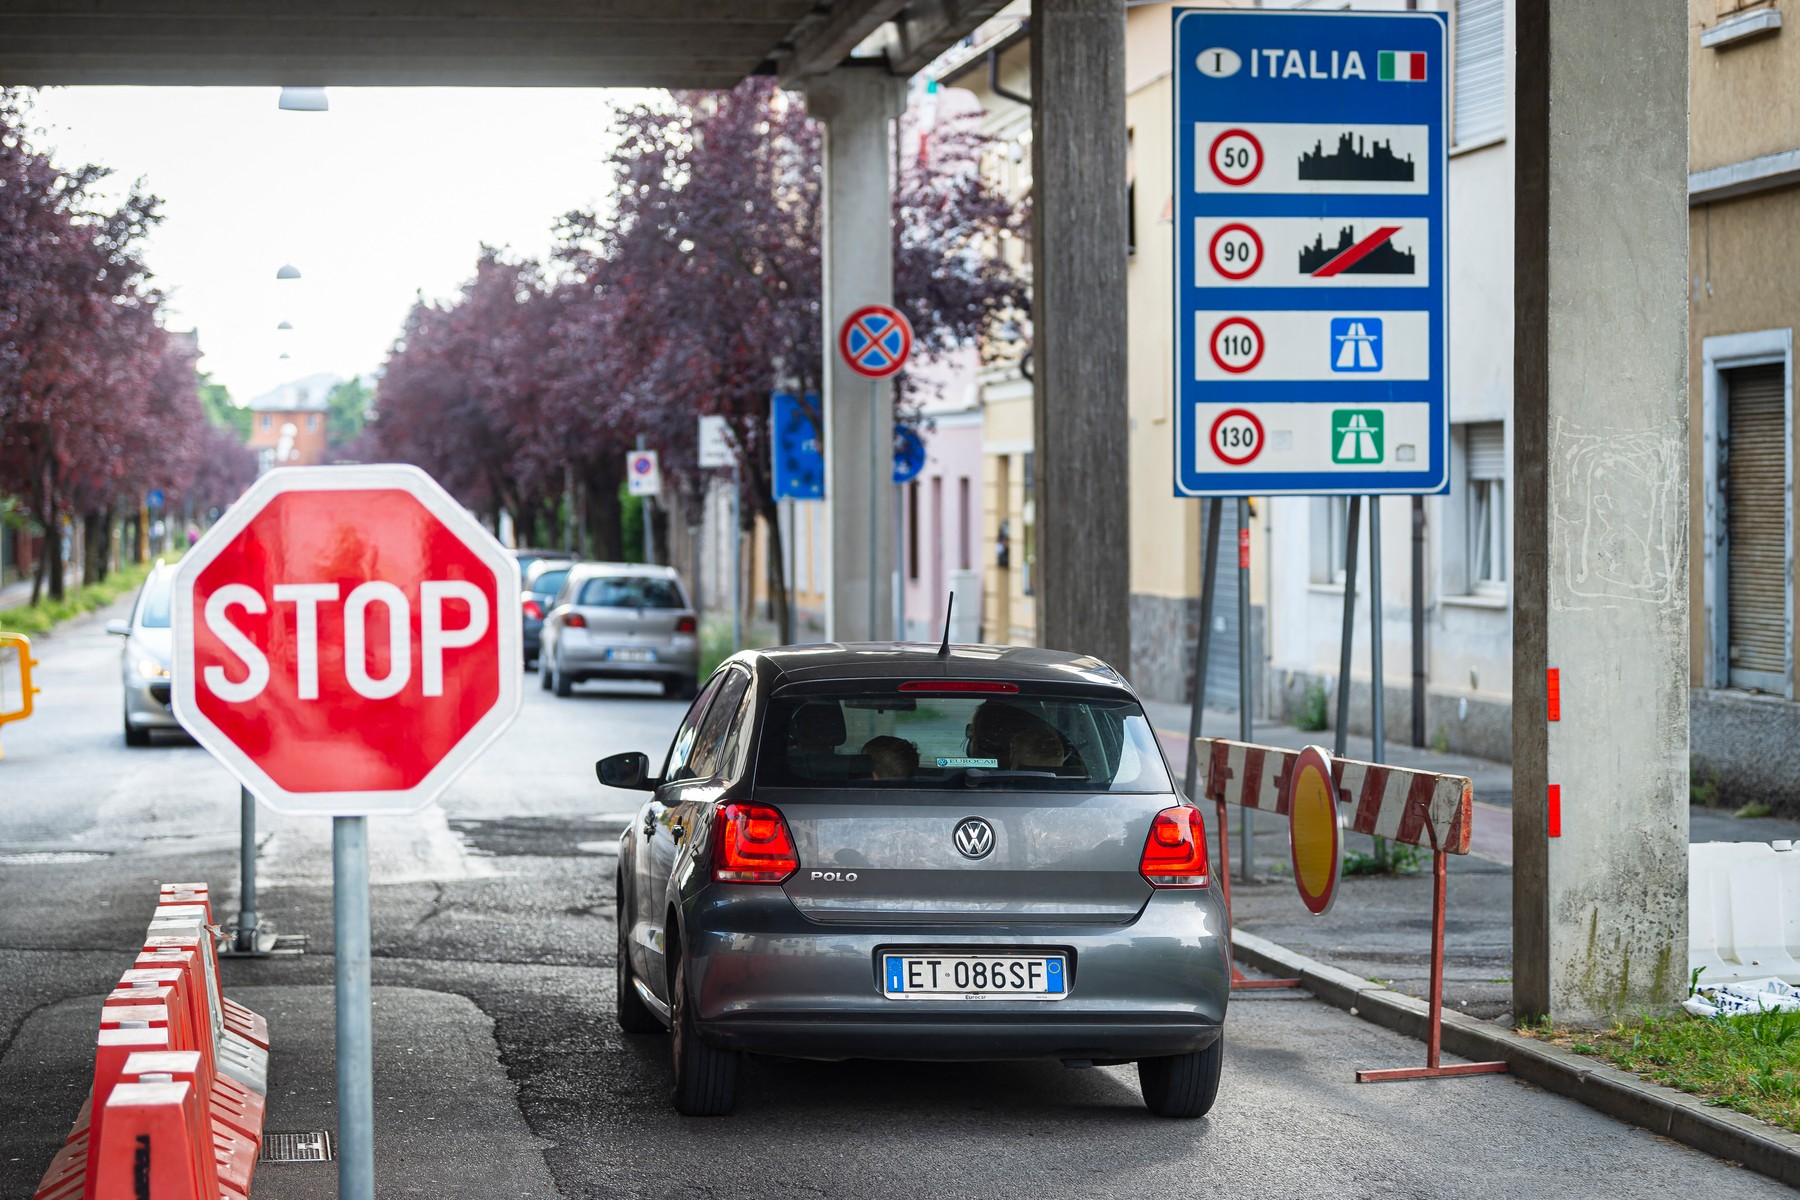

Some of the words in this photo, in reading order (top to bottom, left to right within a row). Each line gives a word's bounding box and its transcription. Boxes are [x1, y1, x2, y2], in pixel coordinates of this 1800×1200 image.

[1250, 48, 1367, 80] ITALIA
[1223, 147, 1250, 168] 50
[1224, 241, 1250, 262] 90
[1223, 334, 1252, 356] 110
[1221, 427, 1254, 447] 130
[203, 580, 490, 703] STOP
[949, 757, 997, 765] EUROCAR
[810, 871, 858, 882] POLO
[908, 960, 942, 989] ET
[954, 961, 1043, 989] 086SF
